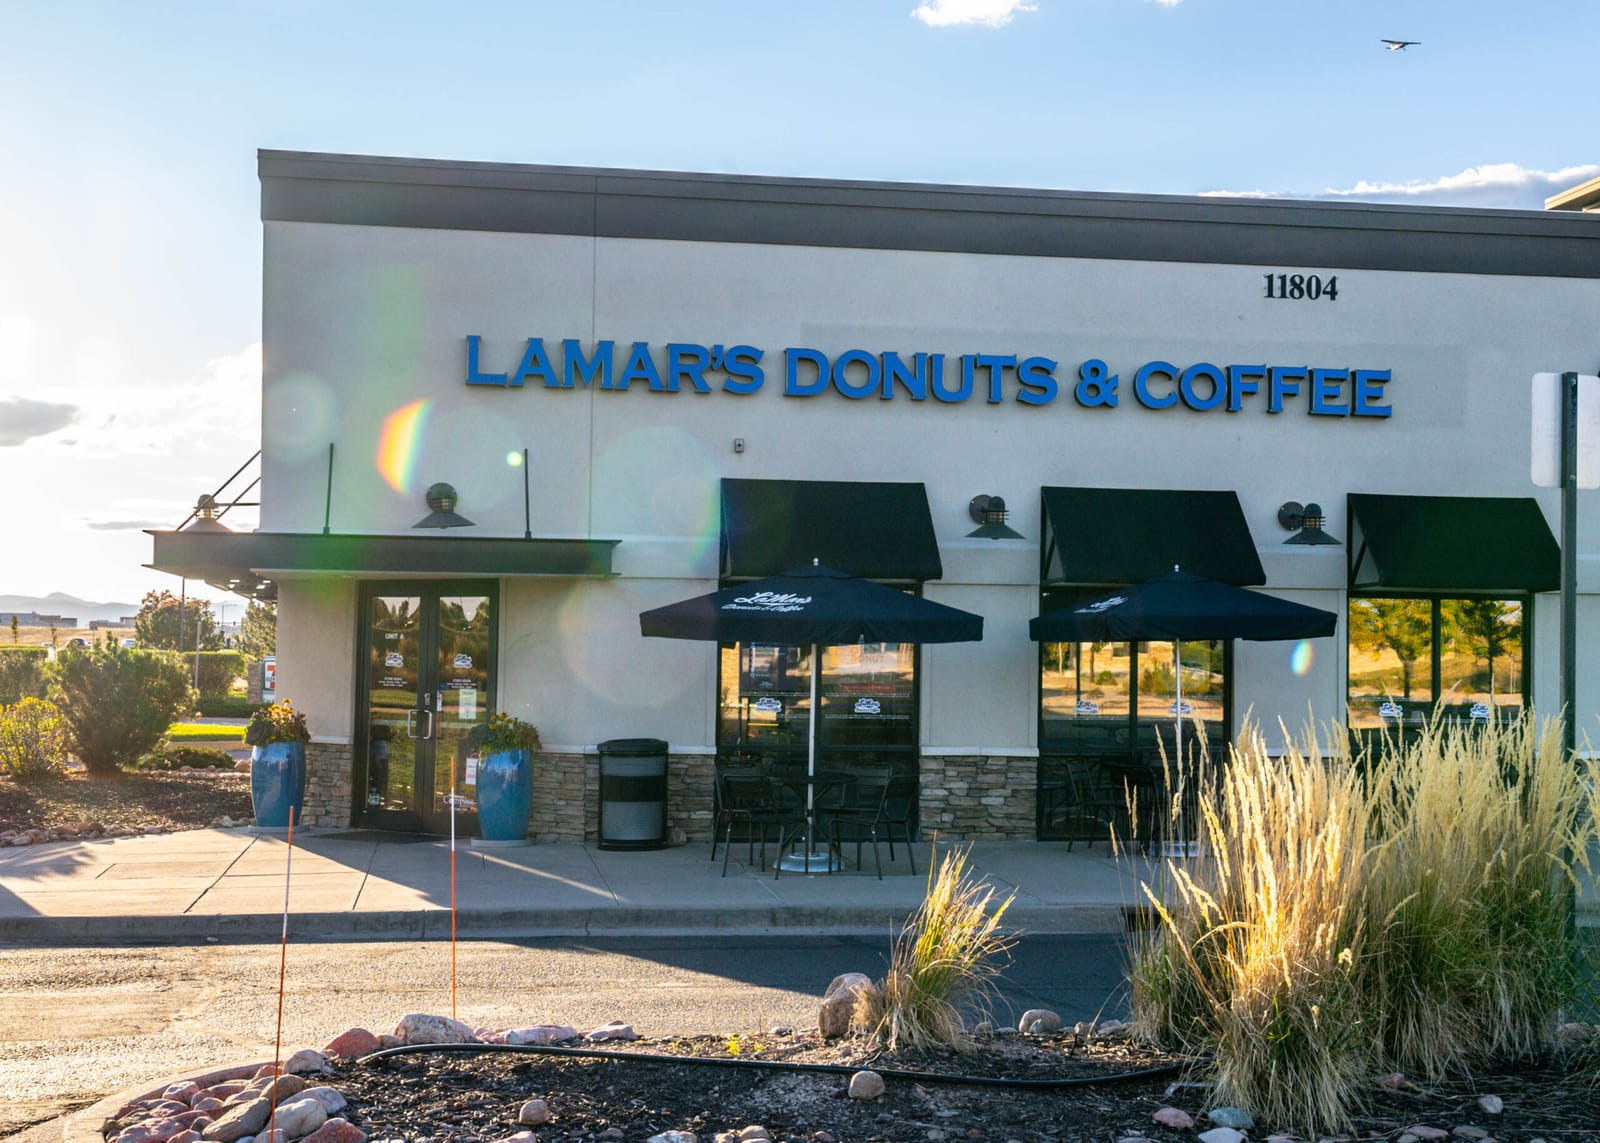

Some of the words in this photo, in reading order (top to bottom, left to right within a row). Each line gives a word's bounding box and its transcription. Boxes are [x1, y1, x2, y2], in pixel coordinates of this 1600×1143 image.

[1263, 273, 1338, 301] 11804
[465, 335, 765, 394] LAMAR'S
[784, 348, 1058, 407] DONUTS
[1074, 359, 1119, 408] &
[1133, 361, 1392, 418] COFFEE
